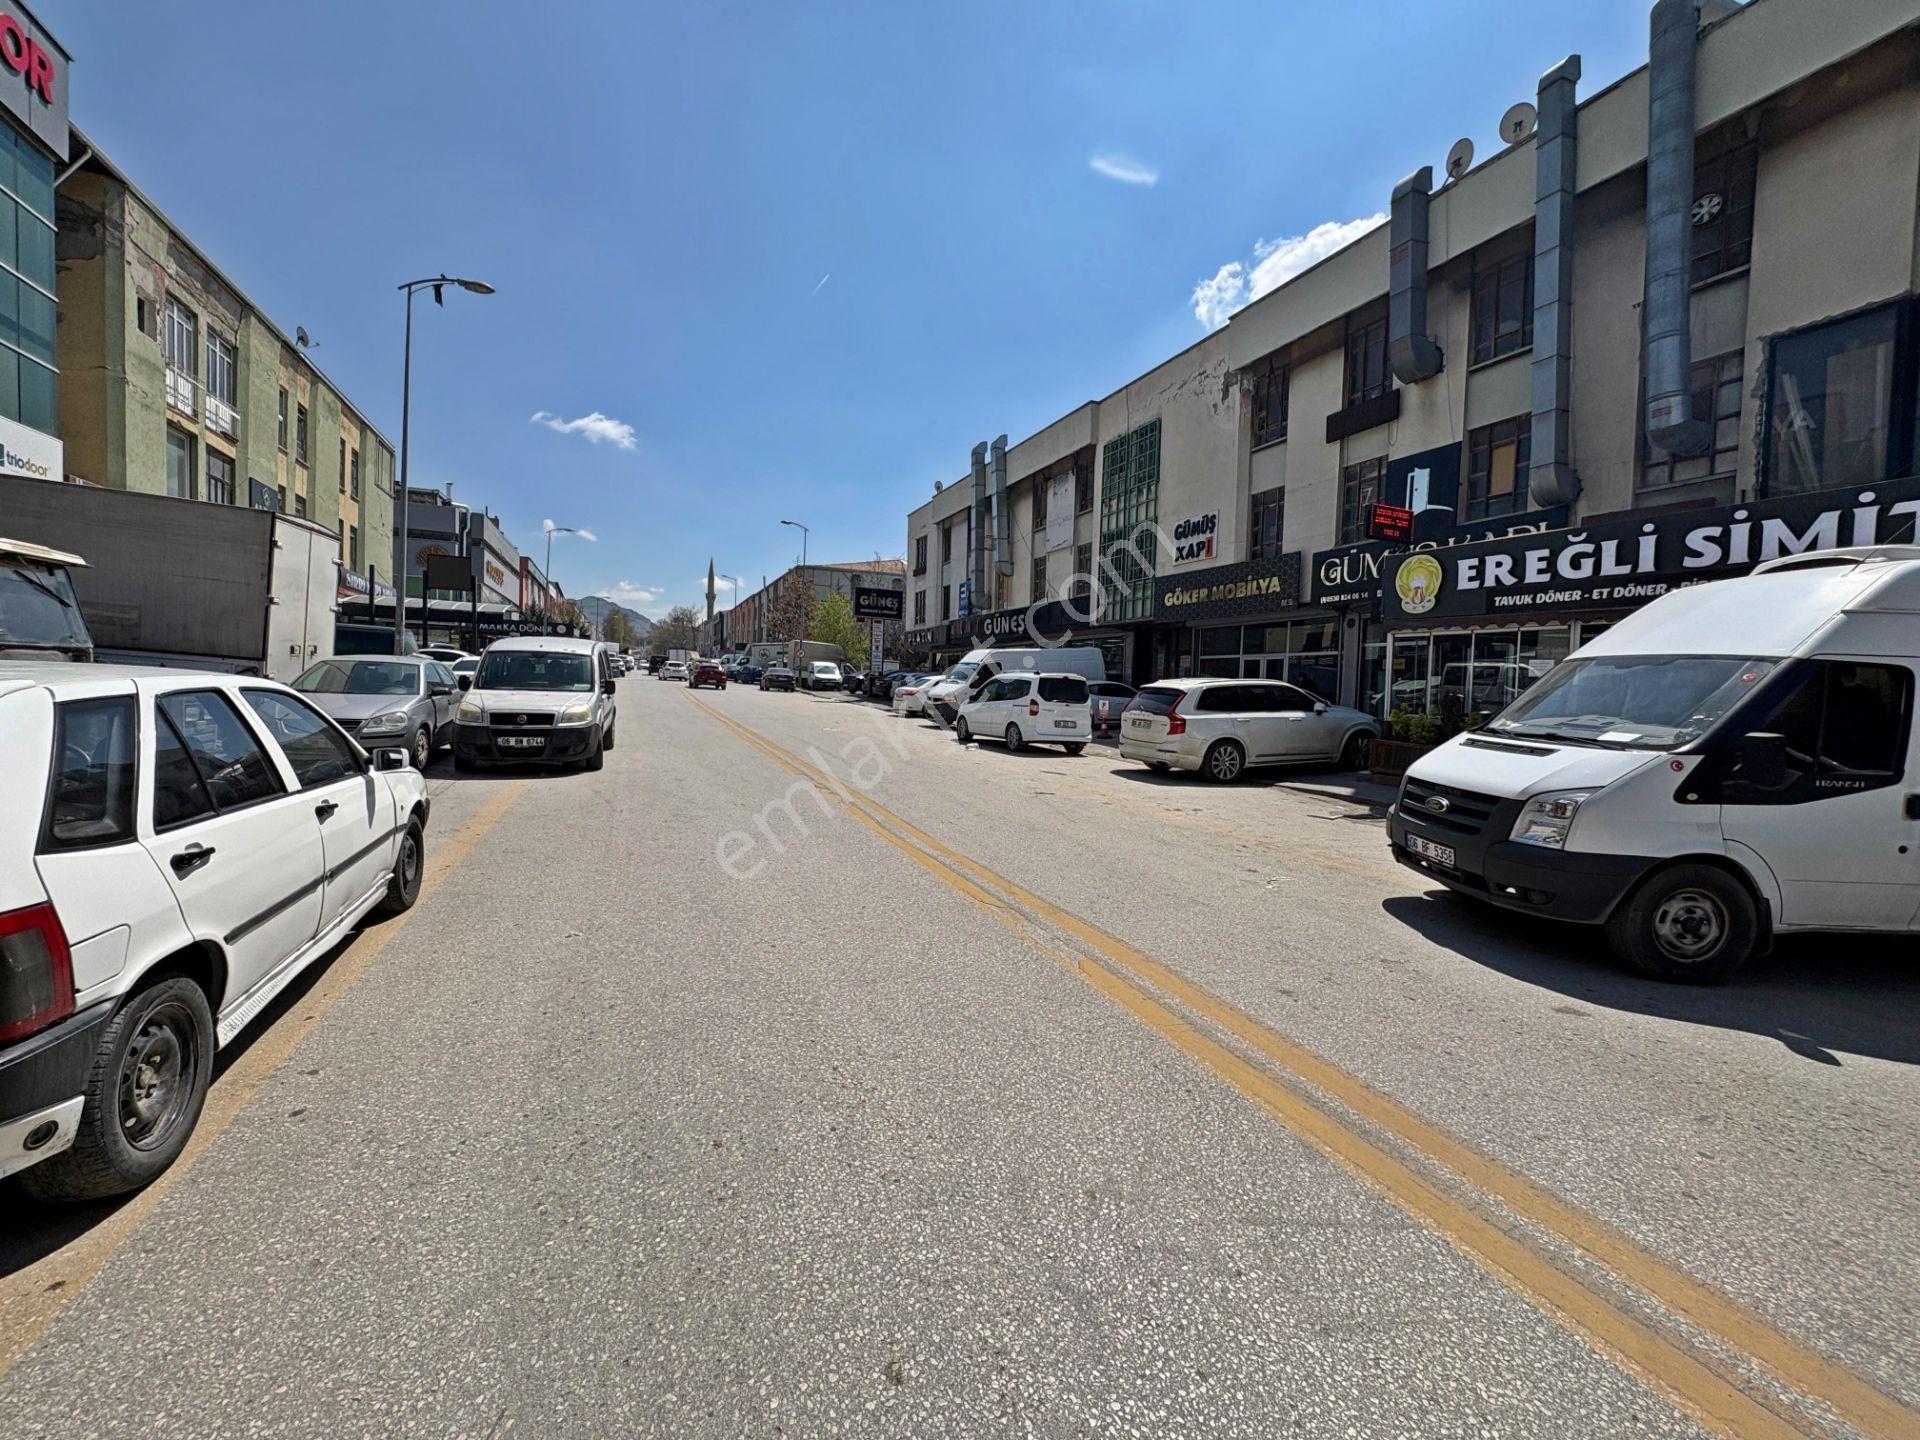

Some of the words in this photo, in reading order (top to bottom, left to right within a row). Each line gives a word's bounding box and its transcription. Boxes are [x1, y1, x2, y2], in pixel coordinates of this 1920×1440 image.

[6, 450, 48, 477] triodoor
[1174, 514, 1217, 540] GÜMÜŞ
[1457, 523, 1658, 590] EREĞLİ
[1164, 587, 1208, 606] GÖKER
[1212, 575, 1281, 600] MOBİLYA
[1494, 594, 1533, 607] TAVUK
[1536, 589, 1581, 603] DÖNER
[1592, 587, 1611, 600] ET
[1613, 583, 1667, 598] DÖNER
[480, 623, 517, 632] MAKKA
[984, 613, 1025, 634] GÜNEŞ
